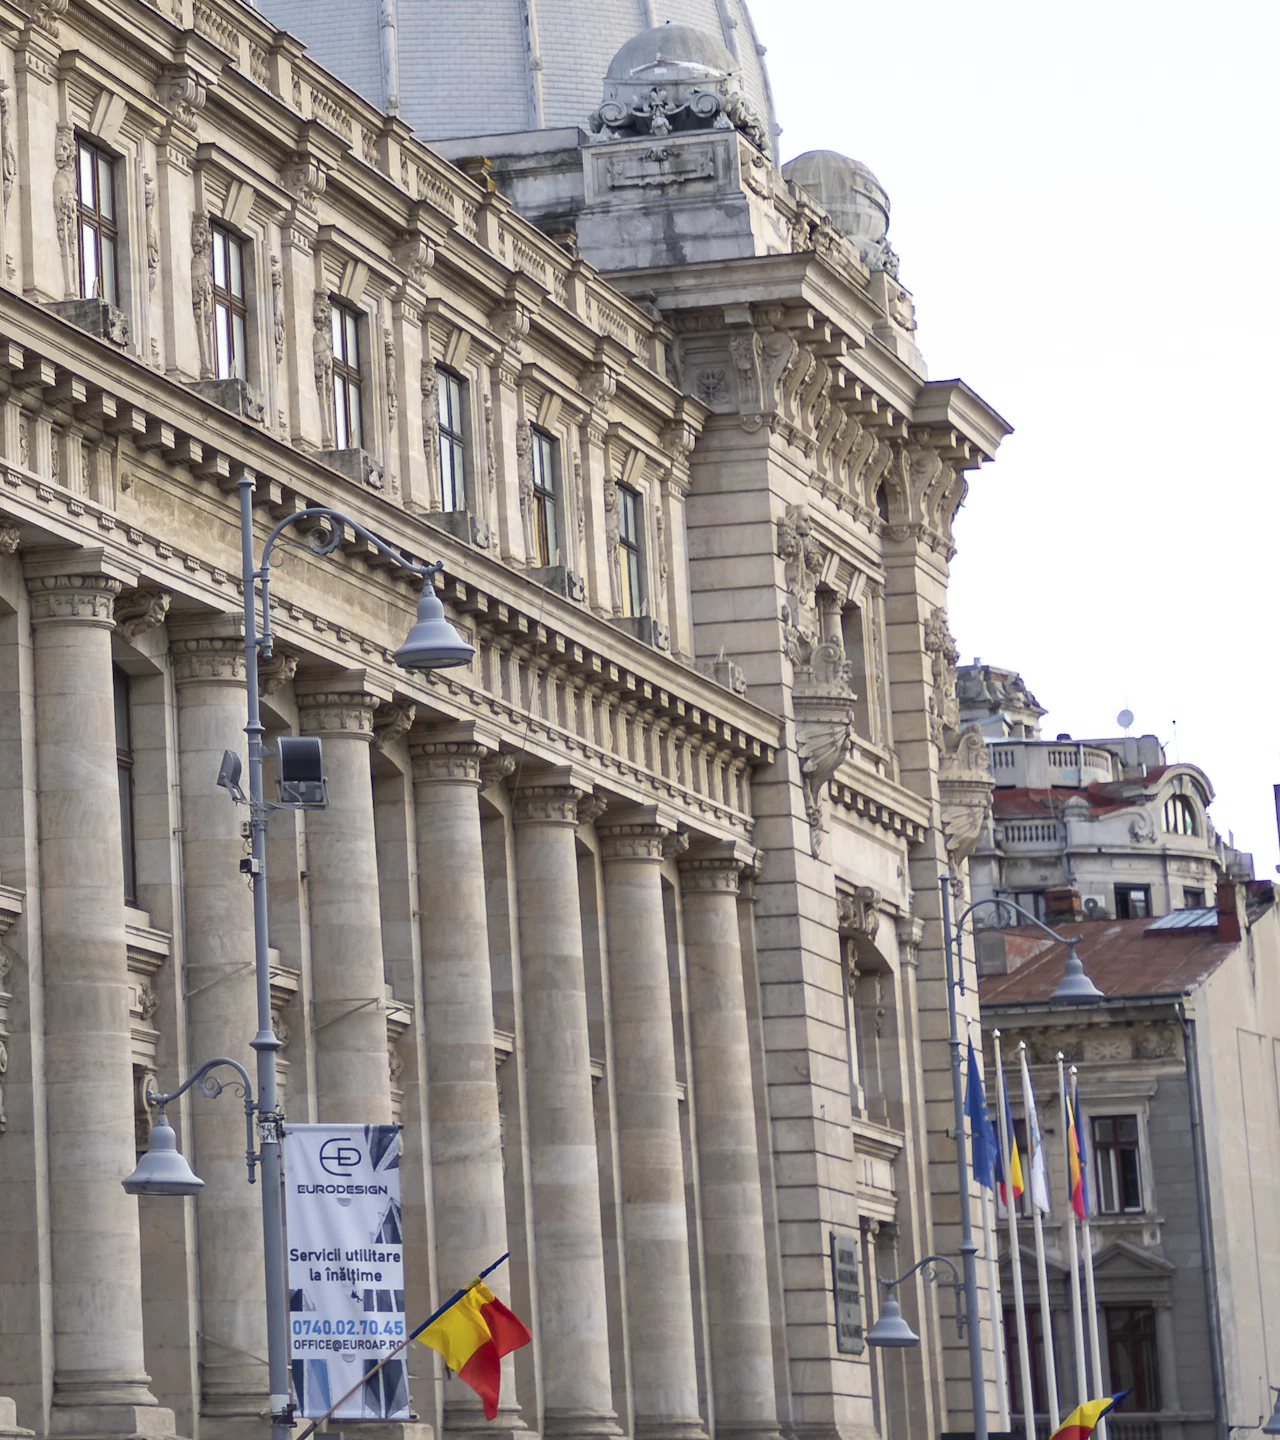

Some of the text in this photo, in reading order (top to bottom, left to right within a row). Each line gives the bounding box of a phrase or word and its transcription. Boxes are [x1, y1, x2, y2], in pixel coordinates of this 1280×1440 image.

[297, 1185, 388, 1195] EURODESIGN
[290, 1248, 401, 1263] Servicii utilitare
[309, 1268, 322, 1282] la
[292, 1320, 404, 1336] 0740.02.70.45
[293, 1339, 405, 1352] OFFICE@EUROAP.RO
